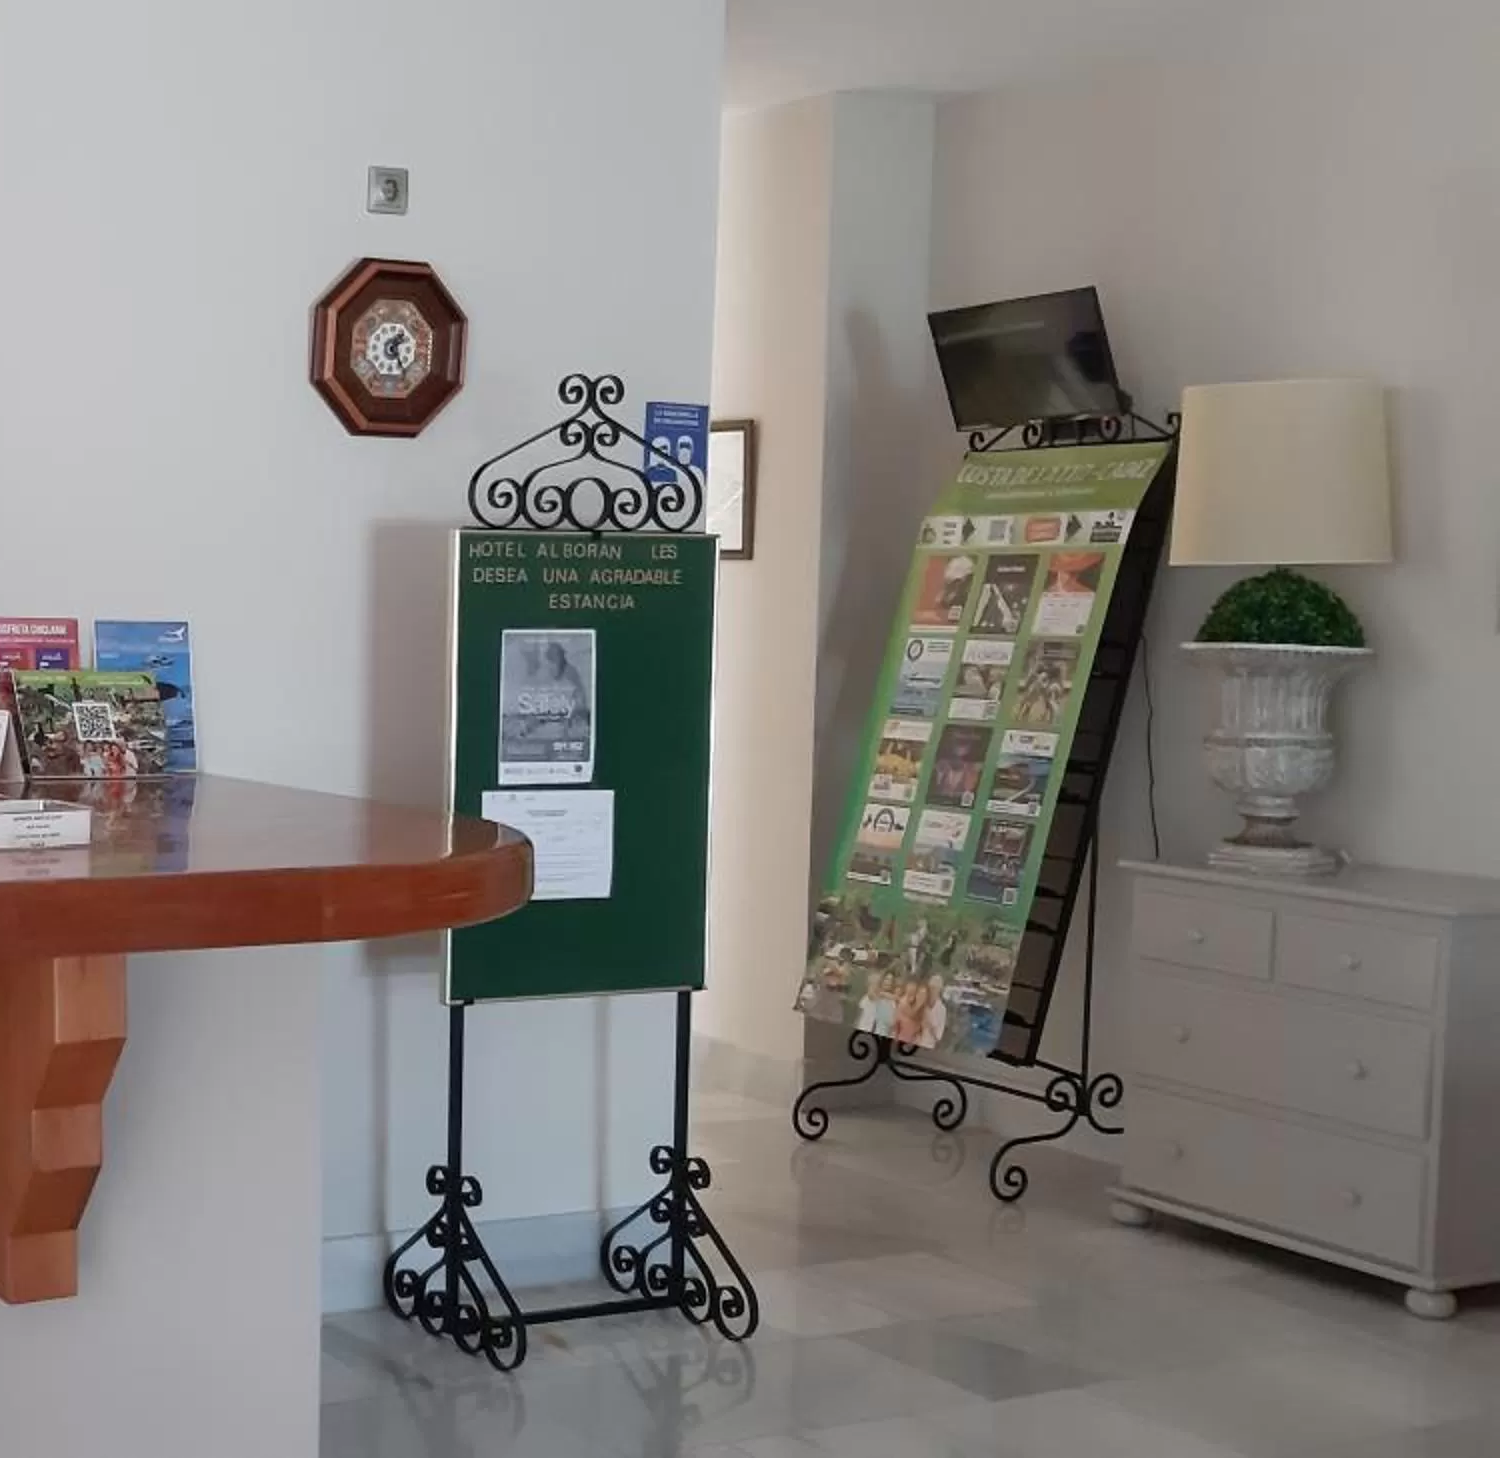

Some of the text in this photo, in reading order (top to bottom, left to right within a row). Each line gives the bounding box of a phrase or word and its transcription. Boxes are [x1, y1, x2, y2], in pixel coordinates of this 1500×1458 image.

[468, 541, 677, 560] HOTEL ALBORAN LES
[472, 567, 683, 585] DESEA UNA AGRADABLE
[549, 593, 635, 610] ESTANCIA
